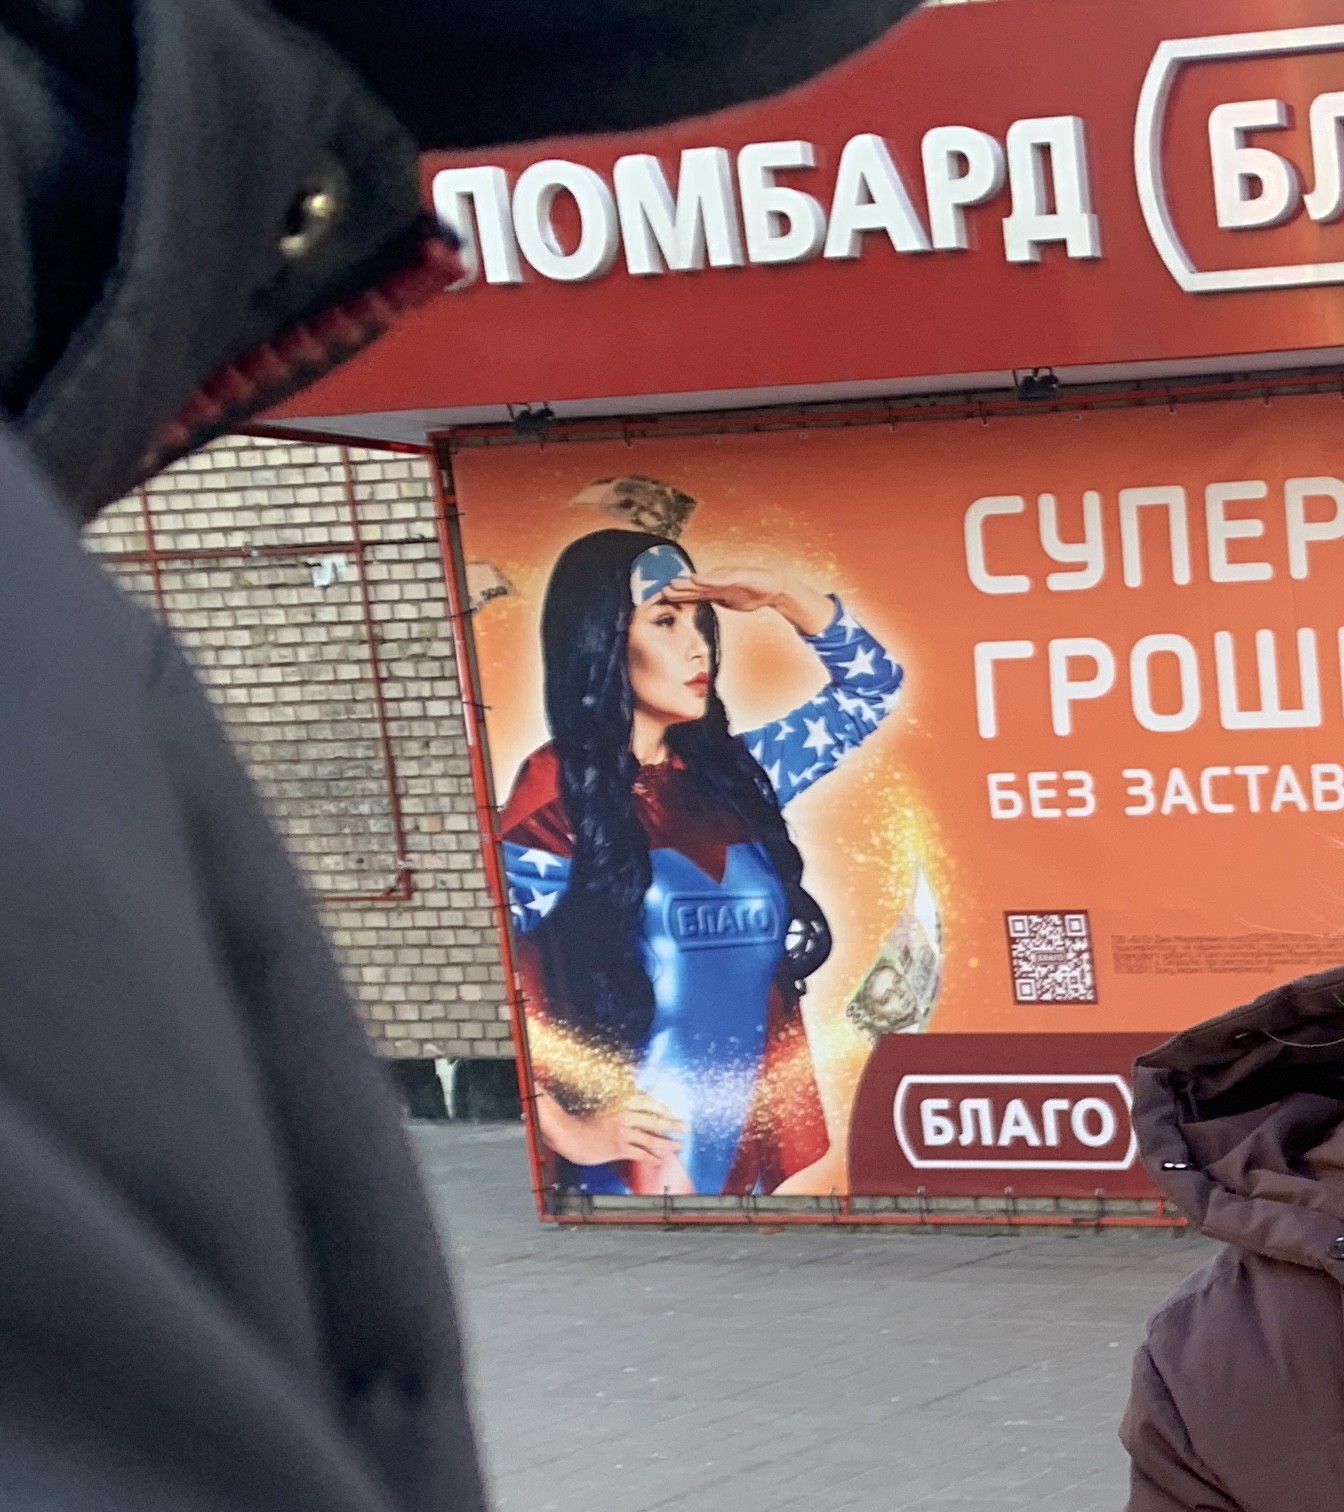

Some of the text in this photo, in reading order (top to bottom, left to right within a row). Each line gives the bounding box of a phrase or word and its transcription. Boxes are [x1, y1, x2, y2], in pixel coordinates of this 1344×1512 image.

[432, 115, 1102, 293] ЛОМБАРД
[987, 769, 1096, 820] БЕЗ
[918, 1096, 1117, 1149] БЛАГО
